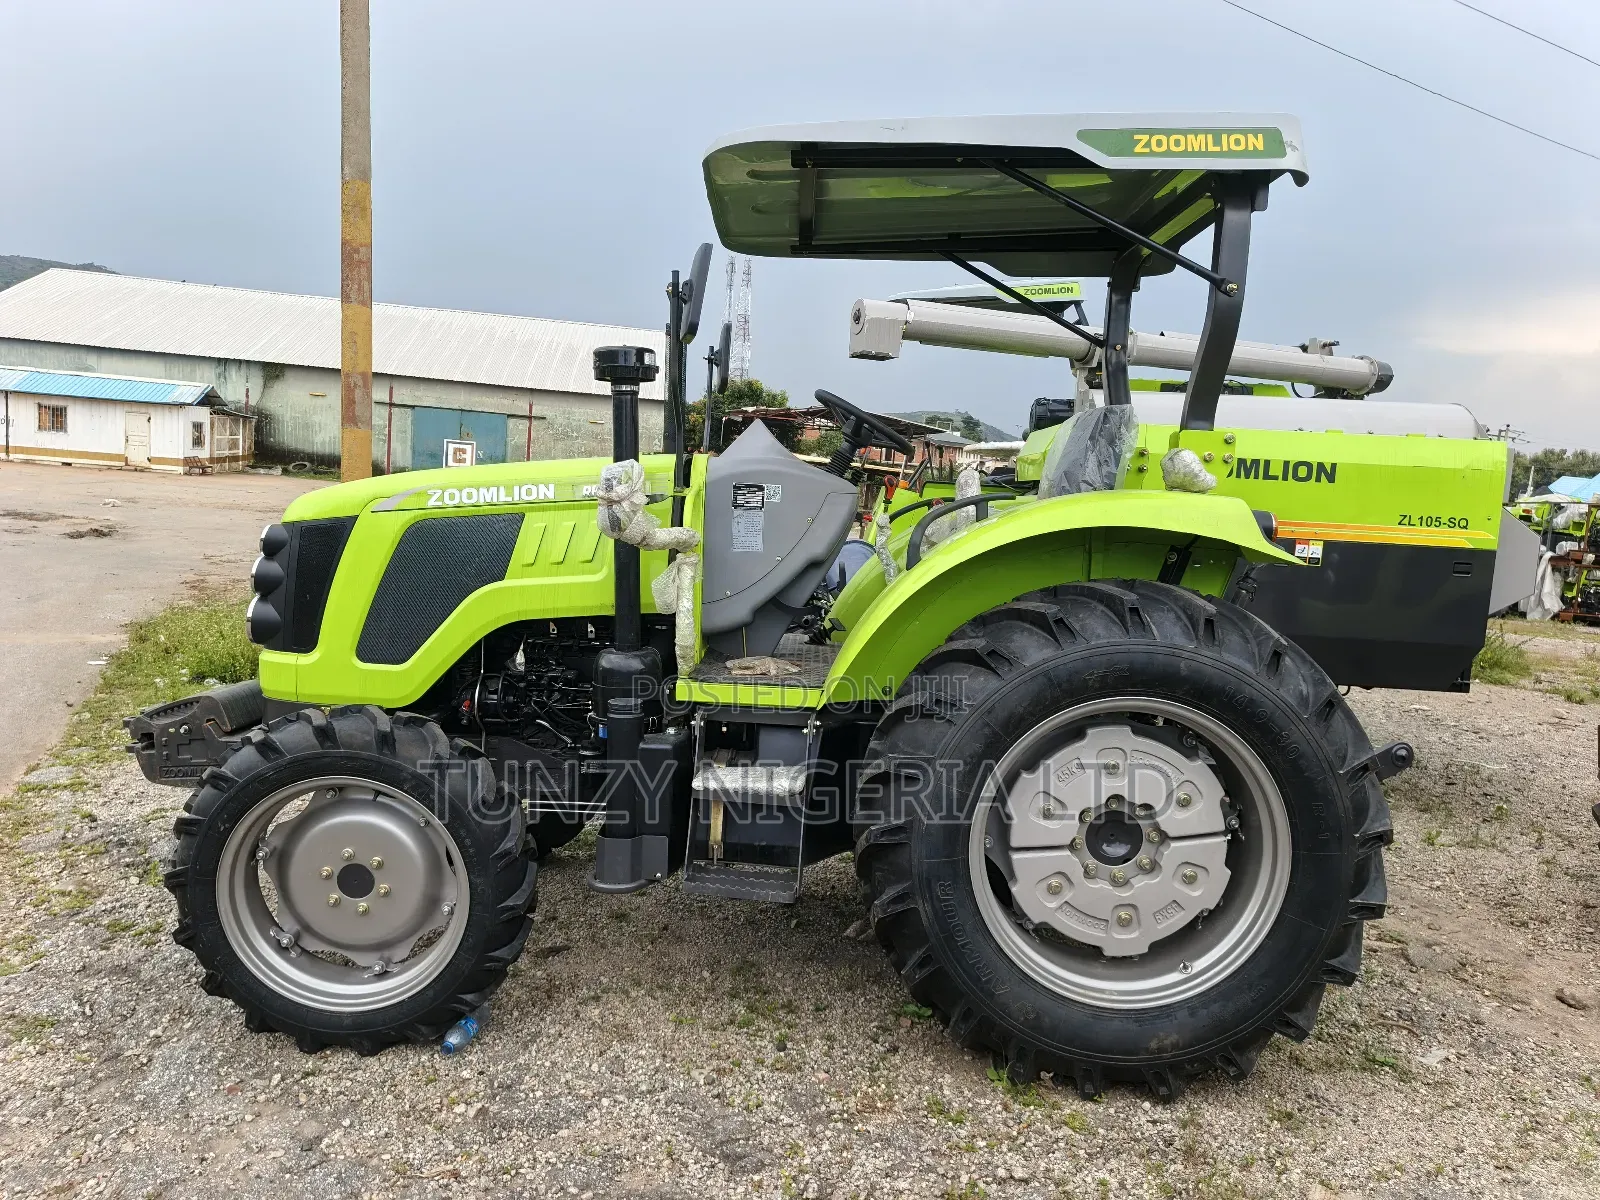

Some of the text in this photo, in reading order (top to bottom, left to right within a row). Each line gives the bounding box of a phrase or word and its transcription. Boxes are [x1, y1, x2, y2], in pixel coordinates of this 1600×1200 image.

[1133, 133, 1264, 153] ZOOMLION
[1023, 286, 1074, 296] ZOOMLION
[1226, 457, 1337, 483] MLION
[427, 483, 555, 507] ZOOMLION
[1398, 514, 1469, 530] ZL105-SQ
[937, 881, 1011, 995] ARMOUR
